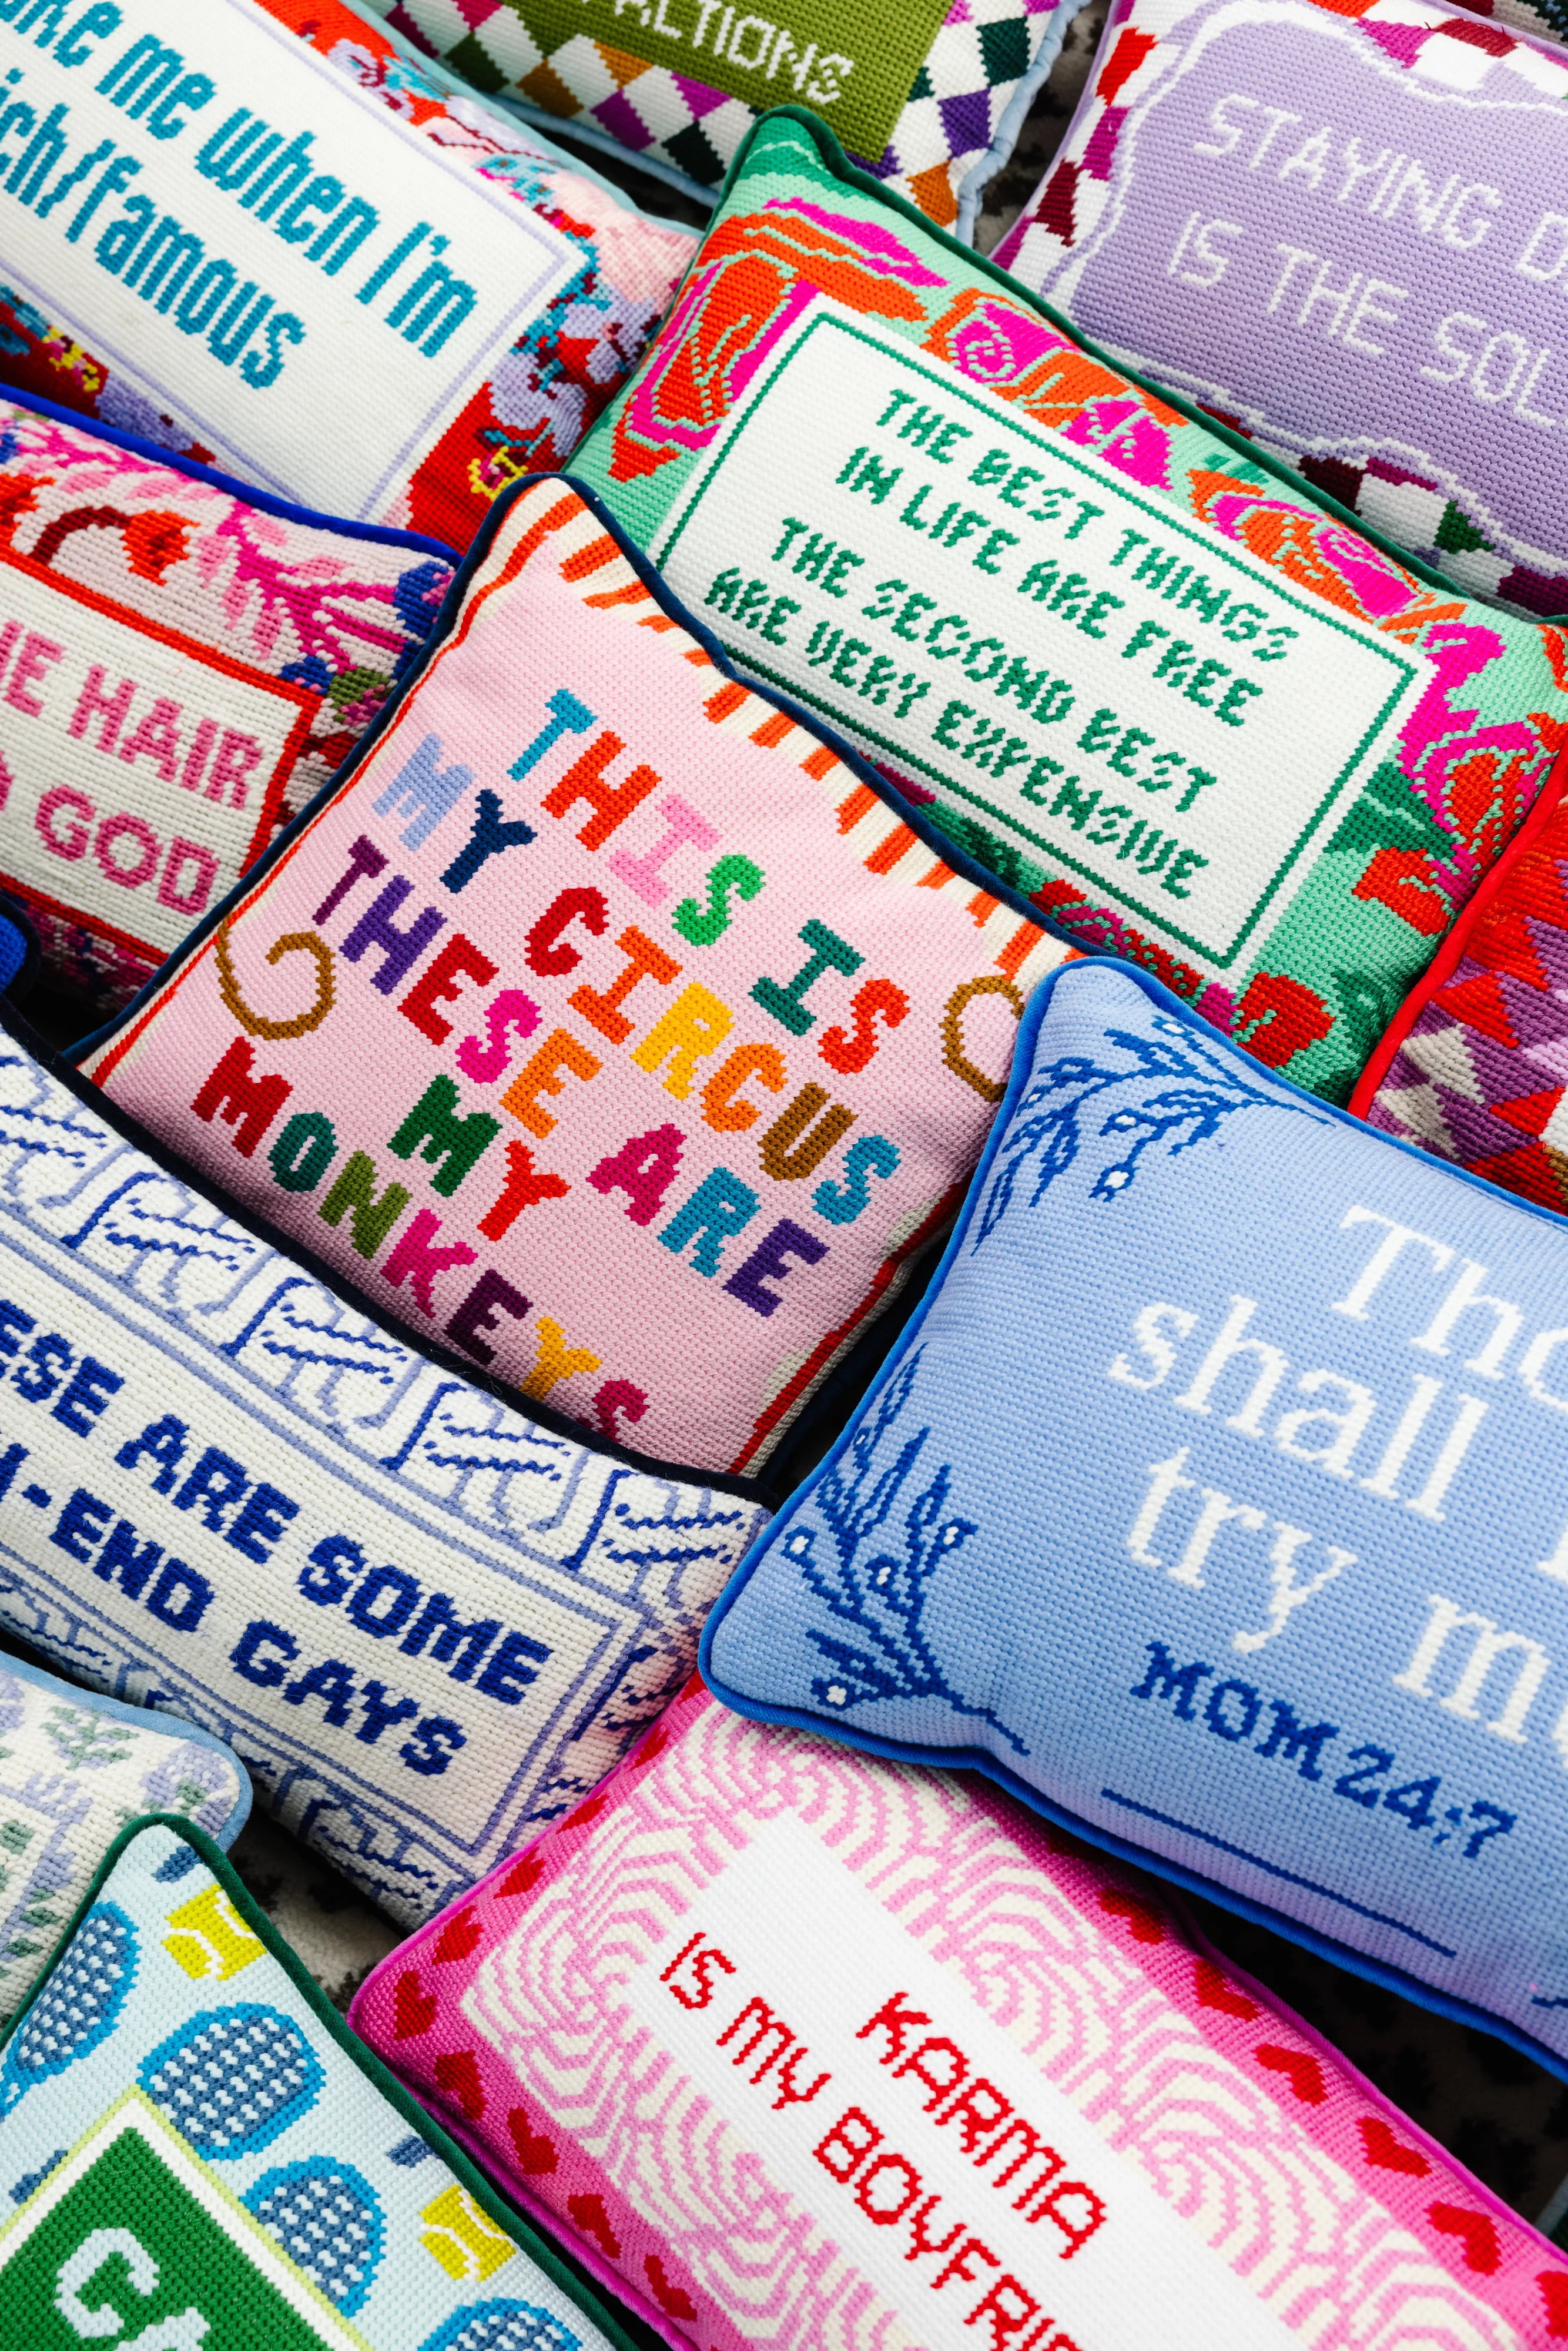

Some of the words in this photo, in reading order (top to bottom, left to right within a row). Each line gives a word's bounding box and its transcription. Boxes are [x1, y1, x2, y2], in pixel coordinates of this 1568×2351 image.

[94, 34, 216, 139] me
[195, 108, 380, 276] when
[356, 221, 477, 357] I'm
[1167, 212, 1242, 288] IS
[1267, 242, 1408, 355] THE
[1418, 312, 1568, 427] SOL
[1194, 93, 1502, 249] STAYING
[1515, 212, 1568, 292] D
[772, 517, 865, 598] THE
[860, 580, 1075, 724] SECOND
[1077, 708, 1216, 812] BEST
[835, 447, 903, 504] IN
[899, 485, 1020, 574] LIFE
[1017, 560, 1124, 639] ARE
[1121, 620, 1265, 728] FREE
[876, 389, 973, 464] THE
[967, 448, 1104, 540] BEST
[1109, 528, 1300, 662] THINGS
[35, 785, 219, 916] GOD
[68, 665, 263, 811] HAIR
[704, 567, 801, 645] ARE
[804, 621, 930, 718] VERY
[930, 700, 1209, 899] EXPENSIVE
[373, 732, 537, 893] MY
[525, 887, 900, 1225] CIRCUS
[505, 688, 765, 946] THIS
[747, 920, 910, 1073] IS
[312, 835, 602, 1138] THESE
[588, 1124, 830, 1317] ARE
[387, 1074, 571, 1241] MY
[191, 1036, 650, 1444] MONKEYS
[1107, 1294, 1489, 1523] shall
[115, 1414, 299, 1563] ARE
[297, 1535, 555, 1706] SOME
[229, 1620, 468, 1776] GAYS
[1126, 1446, 1358, 1654] try
[1392, 1593, 1568, 1768] m
[1130, 1642, 1339, 1781] MOM
[660, 1932, 737, 2010] IS
[716, 1997, 831, 2110] MY
[812, 2106, 1083, 2351] BOYFRI
[855, 1991, 1107, 2259] KARMA
